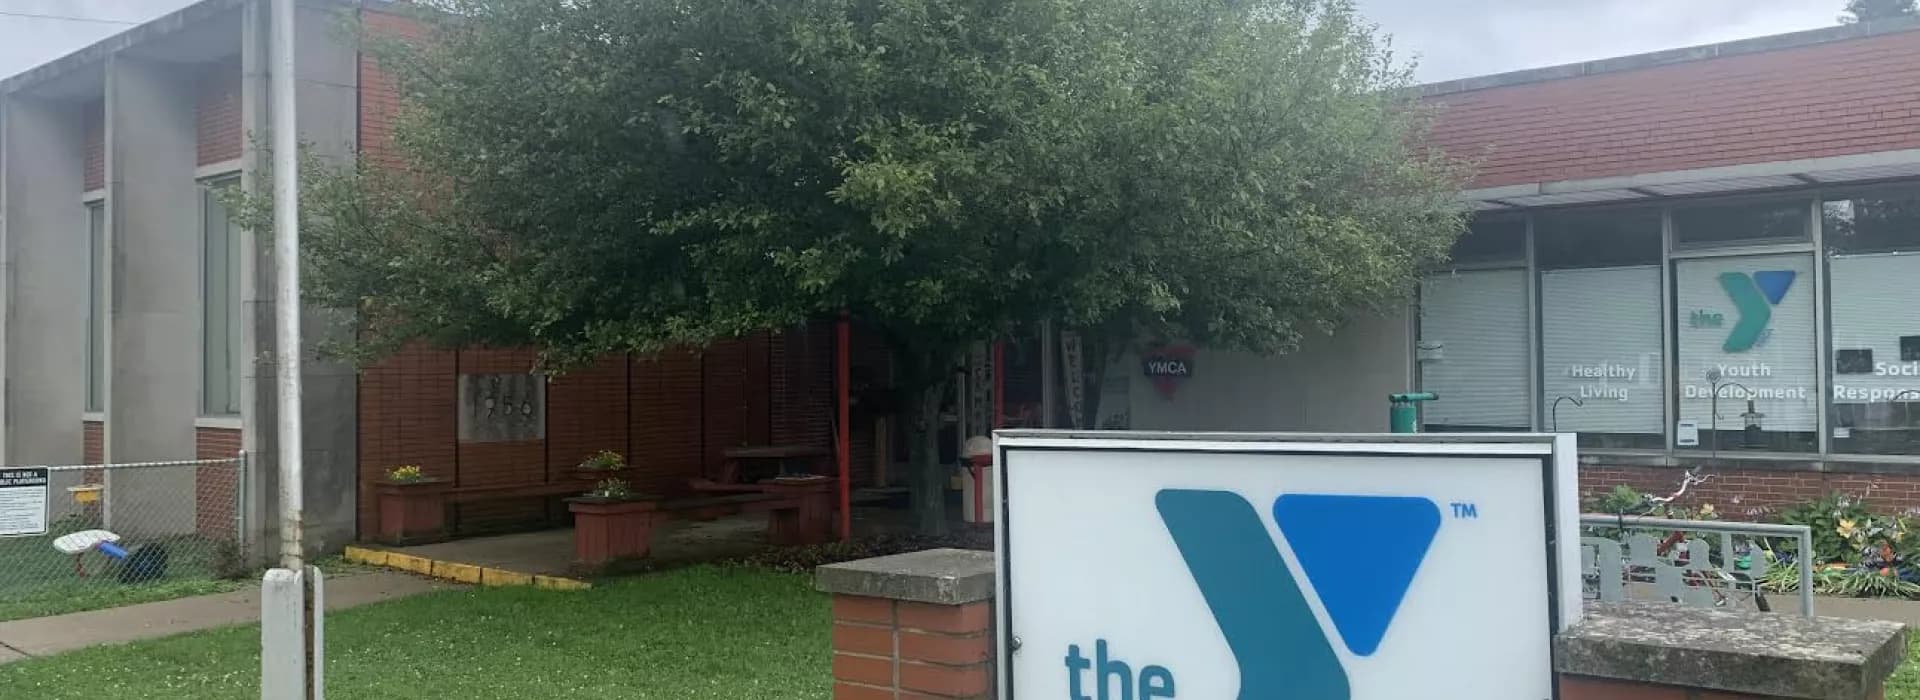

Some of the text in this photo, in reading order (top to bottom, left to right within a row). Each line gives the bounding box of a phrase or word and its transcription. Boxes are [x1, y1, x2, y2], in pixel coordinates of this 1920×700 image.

[1688, 309, 1724, 329] the
[1148, 360, 1188, 375] YMCA
[1571, 363, 1636, 381] Healthy
[1717, 362, 1772, 377] Youth
[1875, 361, 1919, 376] Soci
[1580, 384, 1629, 401] Living
[1684, 383, 1807, 402] Development
[1833, 383, 1920, 403] Respons
[1450, 503, 1477, 519] TM
[1065, 638, 1175, 700] the
